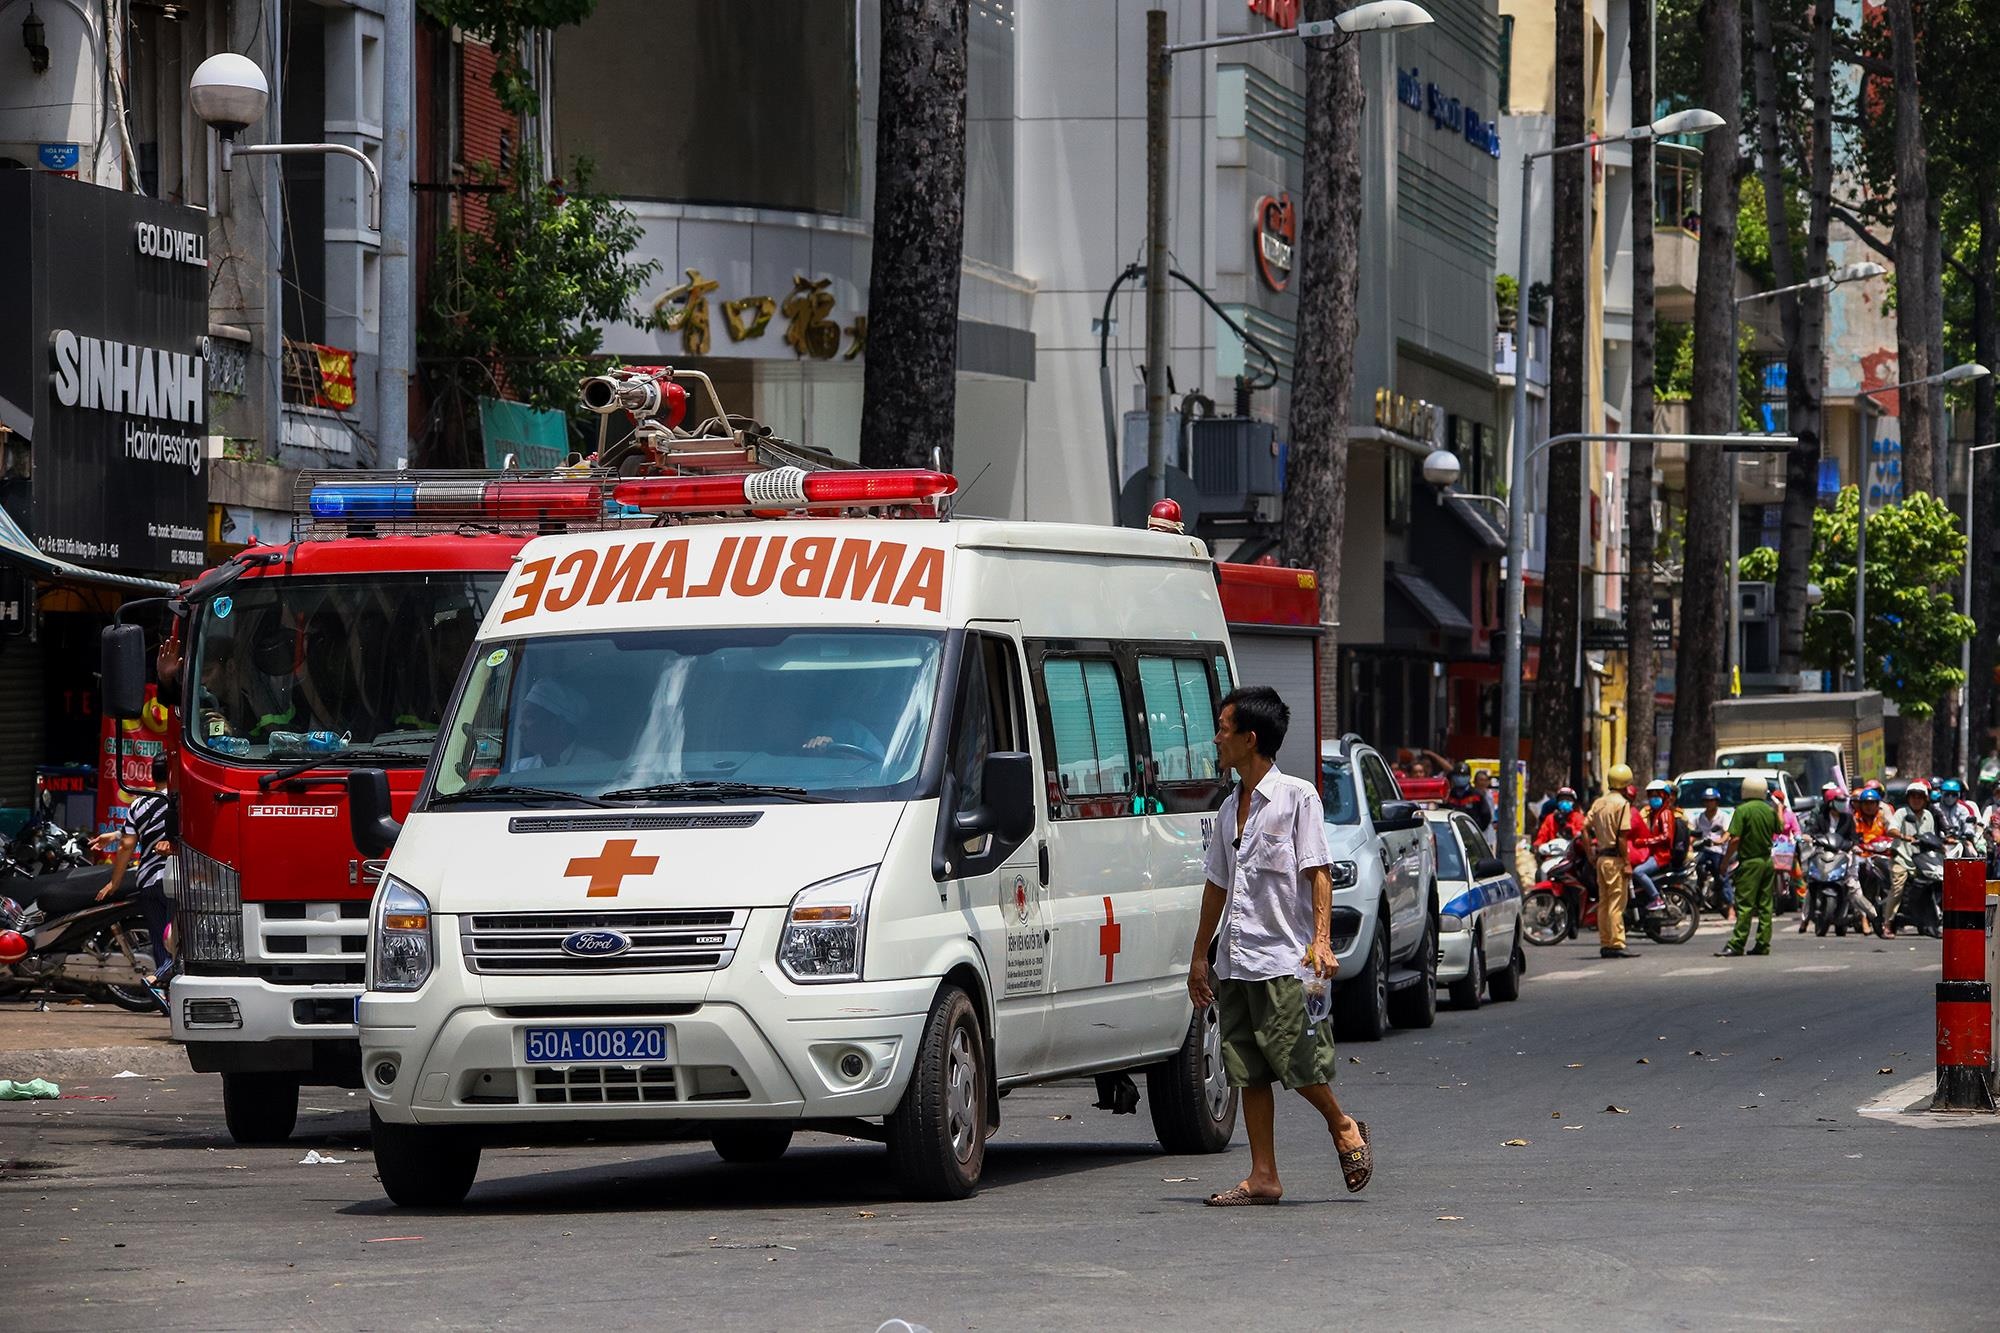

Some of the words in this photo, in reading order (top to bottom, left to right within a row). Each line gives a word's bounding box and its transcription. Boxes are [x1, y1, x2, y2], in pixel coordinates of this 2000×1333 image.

[137, 221, 208, 267] GOLDWELL
[655, 267, 868, 360] 有口福
[55, 329, 203, 425] SINHANH
[125, 420, 201, 476] Hairdressing
[213, 724, 220, 733] 6
[249, 806, 337, 817] FORWARD
[575, 932, 613, 951] Ford
[529, 1029, 661, 1058] 50A-008.20
